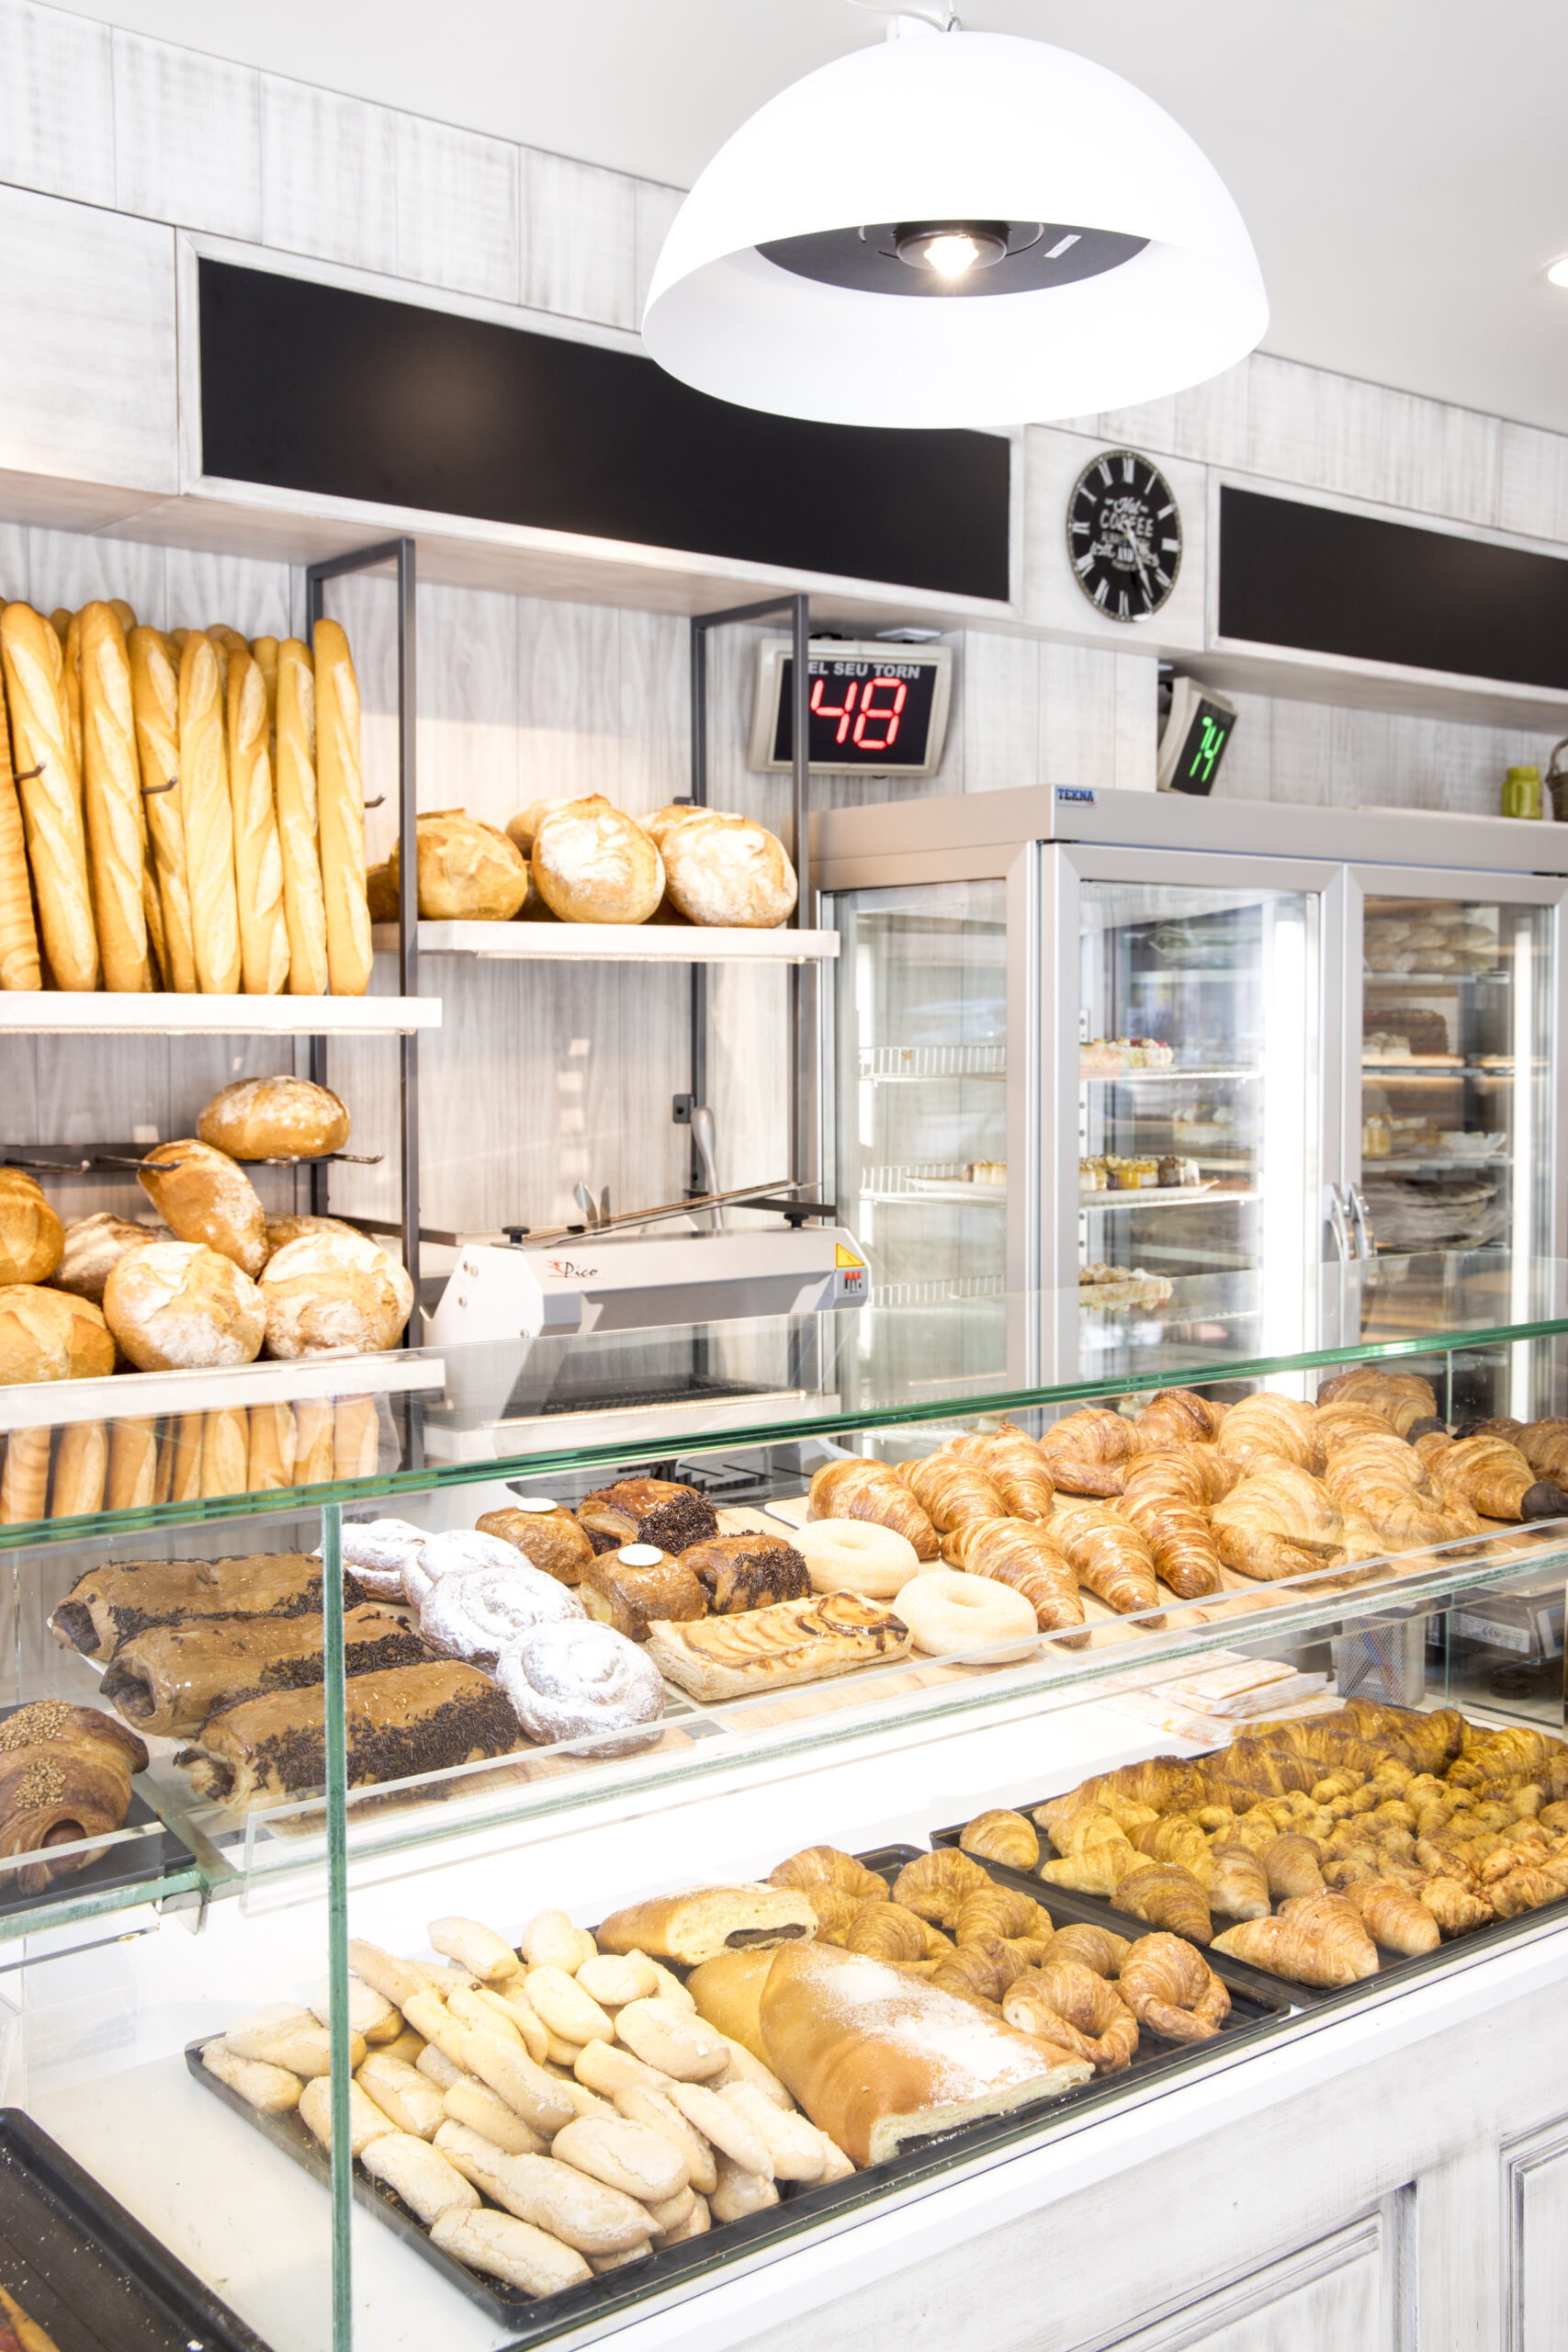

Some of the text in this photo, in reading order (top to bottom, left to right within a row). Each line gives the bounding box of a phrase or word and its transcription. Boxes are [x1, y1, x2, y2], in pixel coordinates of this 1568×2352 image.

[1100, 509, 1155, 537] COFFEE
[808, 661, 920, 679] EL SEU TORN
[810, 677, 908, 750] 48
[1189, 716, 1225, 783] 74
[1057, 787, 1095, 802] TEKNA
[564, 1261, 599, 1279] Pico
